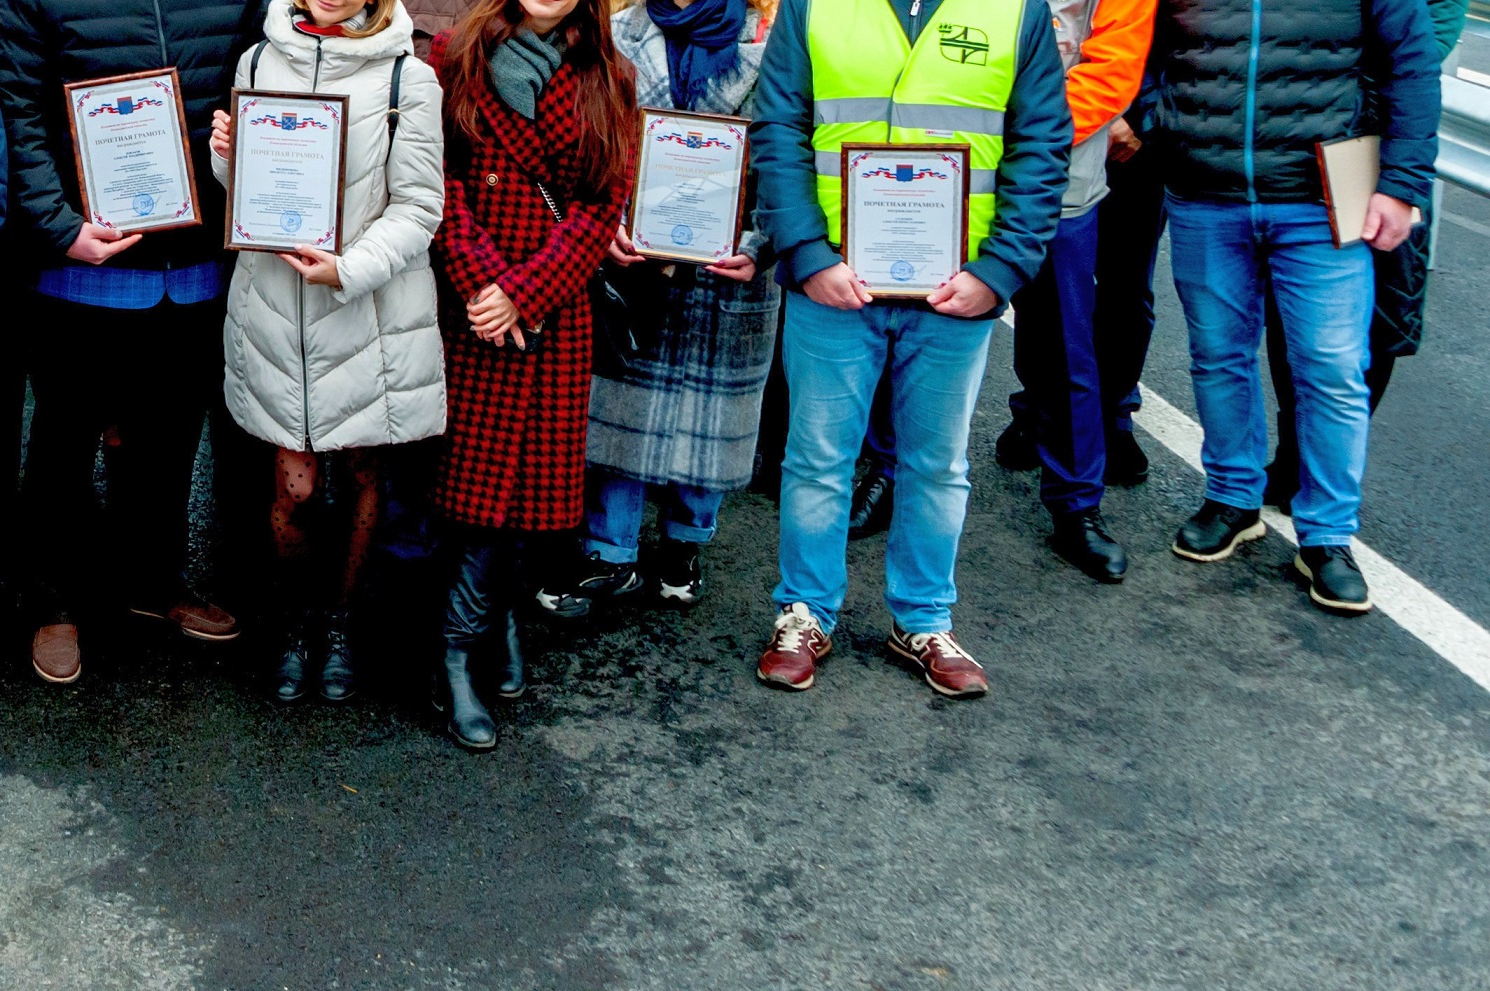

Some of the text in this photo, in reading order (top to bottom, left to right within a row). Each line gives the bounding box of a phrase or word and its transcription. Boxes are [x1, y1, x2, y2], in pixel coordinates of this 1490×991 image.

[94, 129, 166, 146] ПОЧЕТНАЯ ГРАМОТА
[250, 148, 325, 160] ПОЧЕТНАЯ ГРАМОТА
[863, 200, 945, 209] ПОЧЕТНАЯ ГРАМОТА
